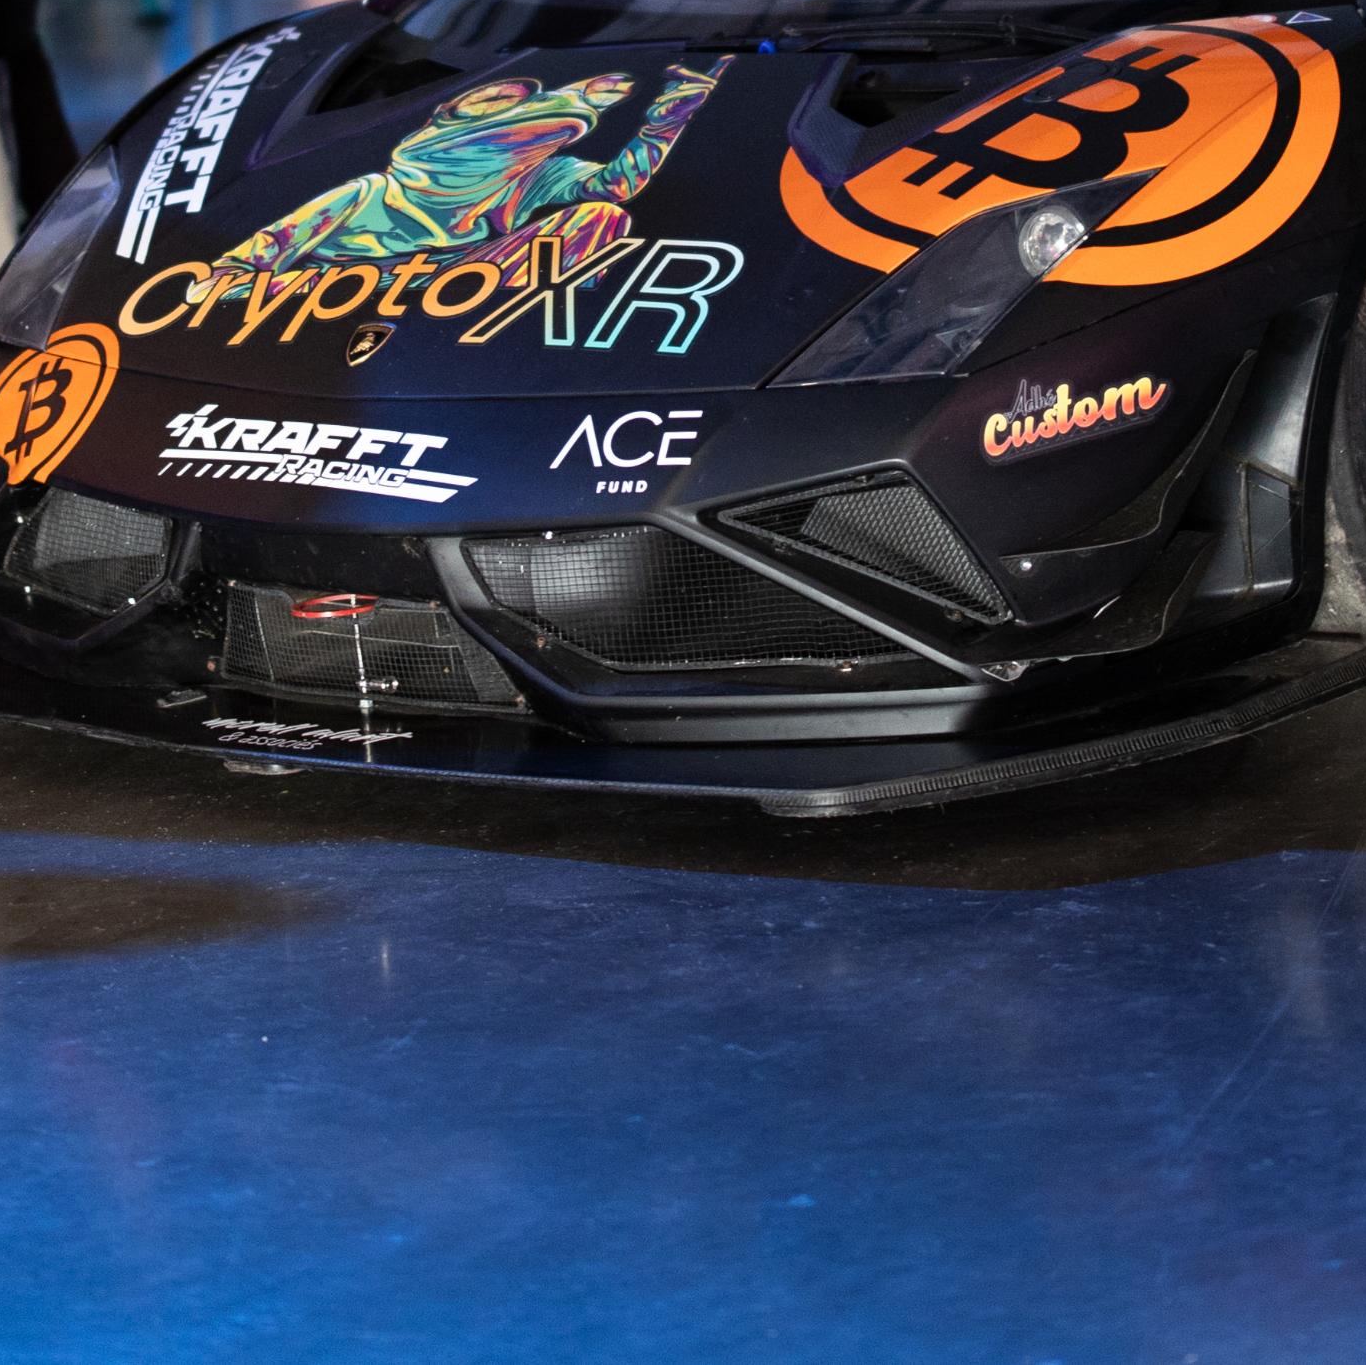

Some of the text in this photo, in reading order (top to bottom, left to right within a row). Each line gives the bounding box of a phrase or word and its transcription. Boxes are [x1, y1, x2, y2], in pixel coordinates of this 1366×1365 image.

[165, 43, 274, 213] KRAFFT
[138, 110, 198, 212] RACING
[118, 236, 745, 354] CryptoXR
[178, 417, 449, 467] KRAFFT
[549, 410, 704, 470] ACE
[984, 376, 1167, 457] Custom
[274, 453, 412, 489] RACING
[595, 480, 649, 494] FUND
[241, 735, 323, 750] associés
